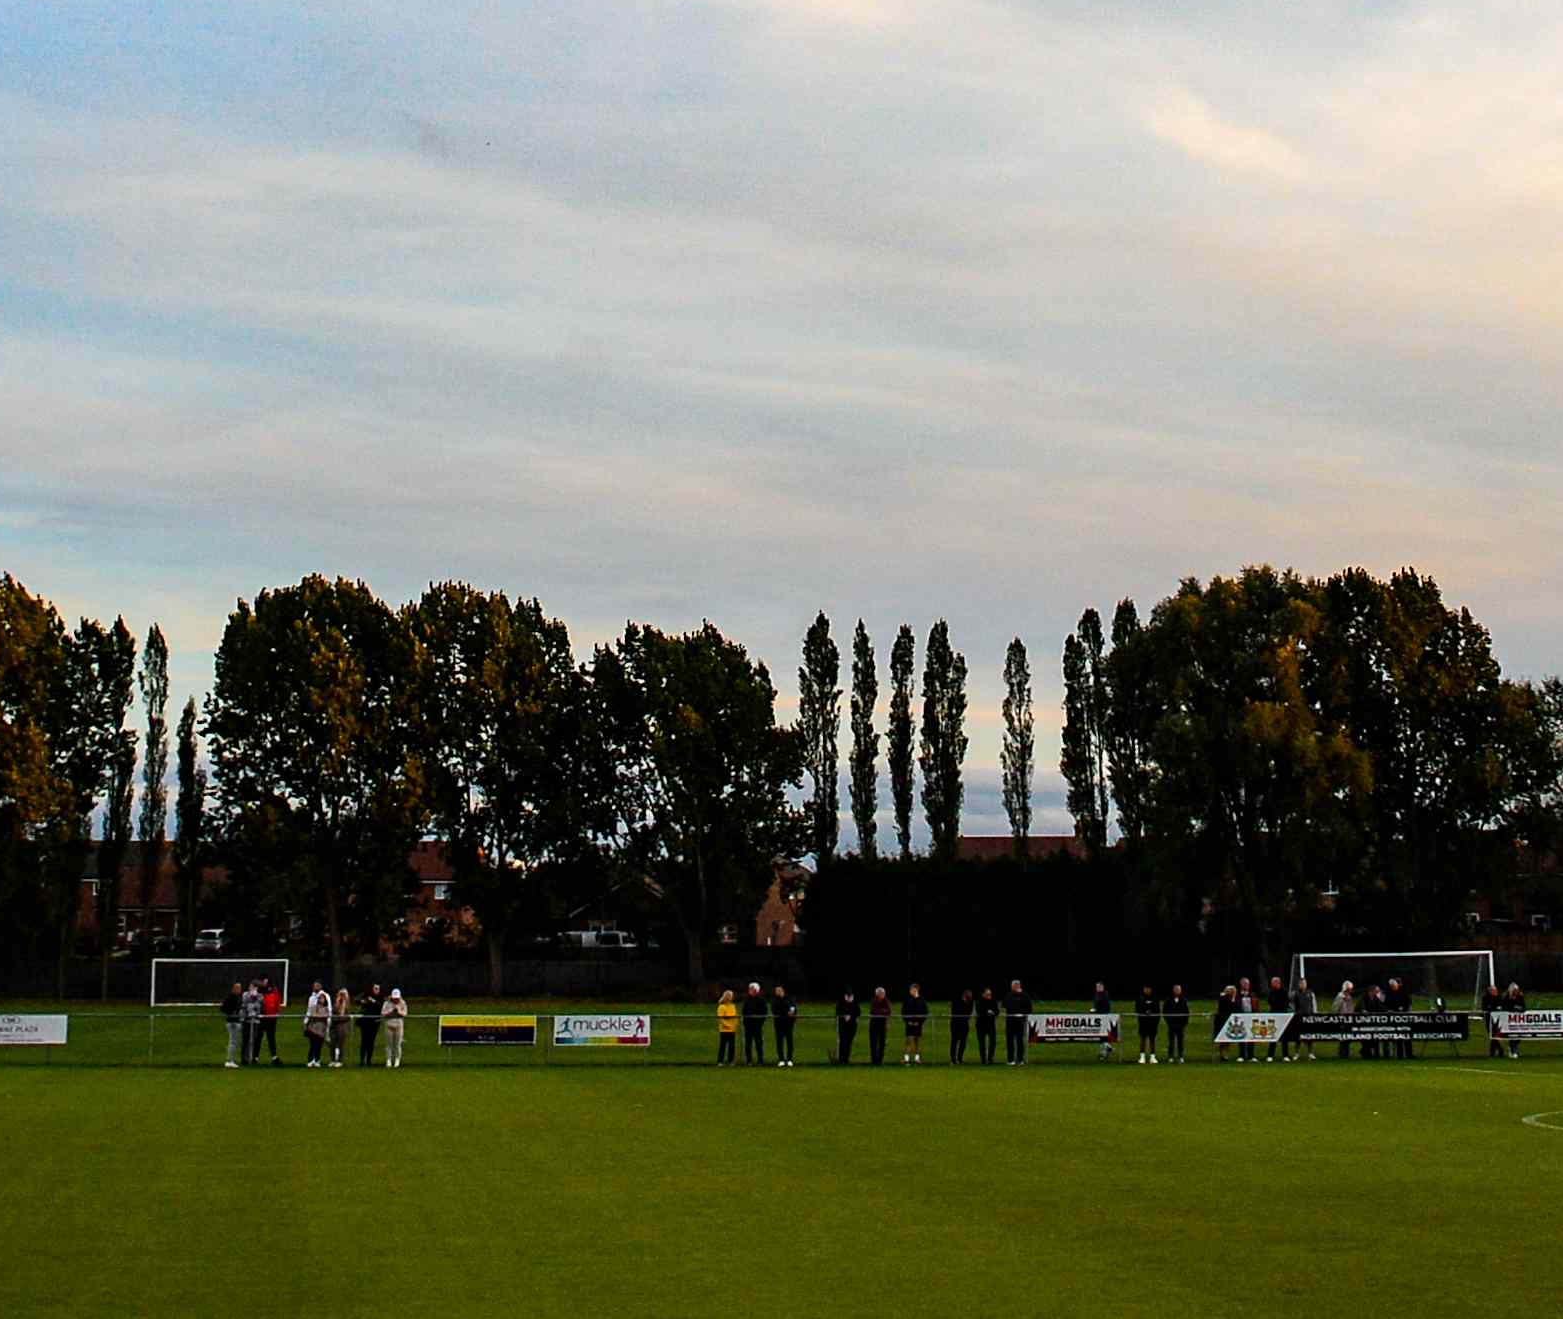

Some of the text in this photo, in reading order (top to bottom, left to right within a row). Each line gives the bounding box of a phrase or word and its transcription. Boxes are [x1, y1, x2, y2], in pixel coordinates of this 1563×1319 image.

[1302, 1015, 1458, 1024] NEWCASTLE UNITED FOOTBALL CLUB
[1508, 1013, 1562, 1024] MHGOALS
[573, 1017, 632, 1031] muckle
[1373, 1032, 1411, 1040] FOOTBALL
